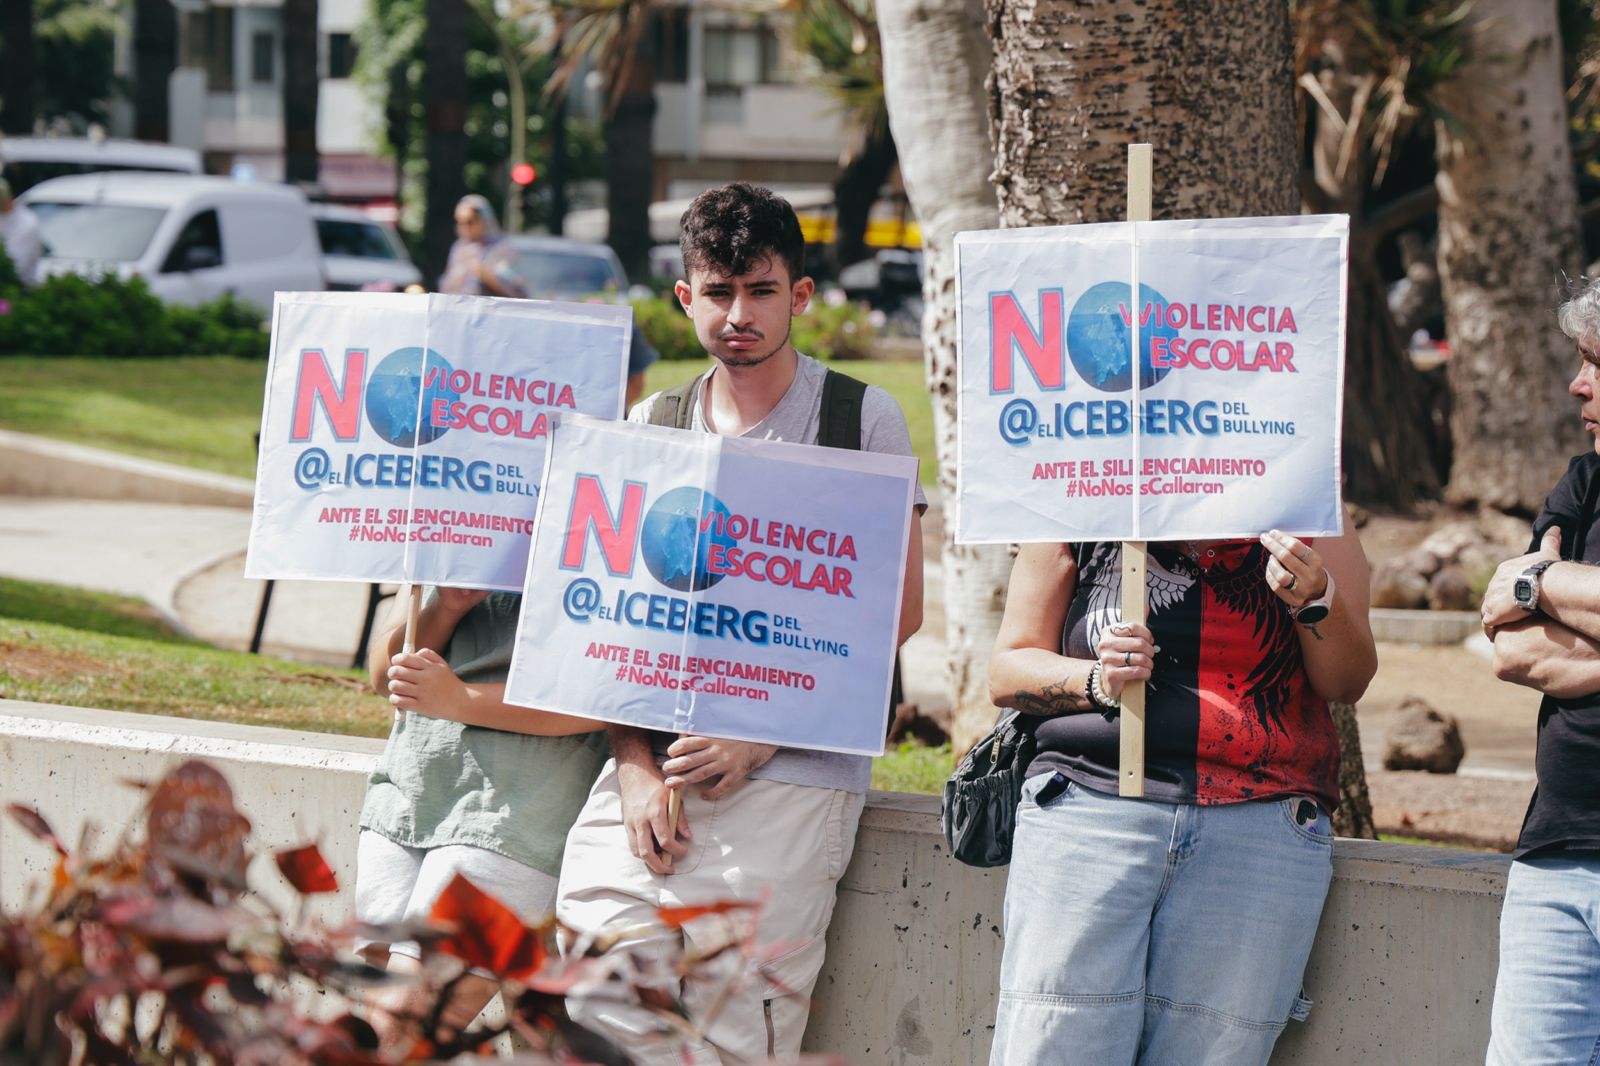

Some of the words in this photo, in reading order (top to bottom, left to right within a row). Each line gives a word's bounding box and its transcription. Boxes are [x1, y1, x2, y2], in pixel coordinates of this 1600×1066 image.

[1150, 337, 1298, 373] ESCOLAR
[422, 366, 577, 409] VIOLENCIA
[431, 398, 548, 439] ESCOLA
[1222, 402, 1250, 415] DEL
[1223, 420, 1296, 435] BULLYING
[496, 463, 524, 479] DEL
[1032, 461, 1076, 479] ANTE
[1080, 460, 1099, 477] EL
[496, 480, 541, 497] BULLY
[318, 507, 361, 524] ANTE
[364, 508, 383, 524] EL
[349, 524, 493, 548] #NoNosCallaran
[695, 508, 858, 561] VIOLENCIA
[707, 544, 856, 599] ESCOLAR
[773, 614, 802, 631] DEL
[773, 631, 849, 657] BULLYING
[584, 642, 629, 663] ANTE
[633, 649, 653, 668] EL
[657, 652, 815, 691] SILENCIAMIENTO
[615, 665, 769, 702] #NoNosCallaran
